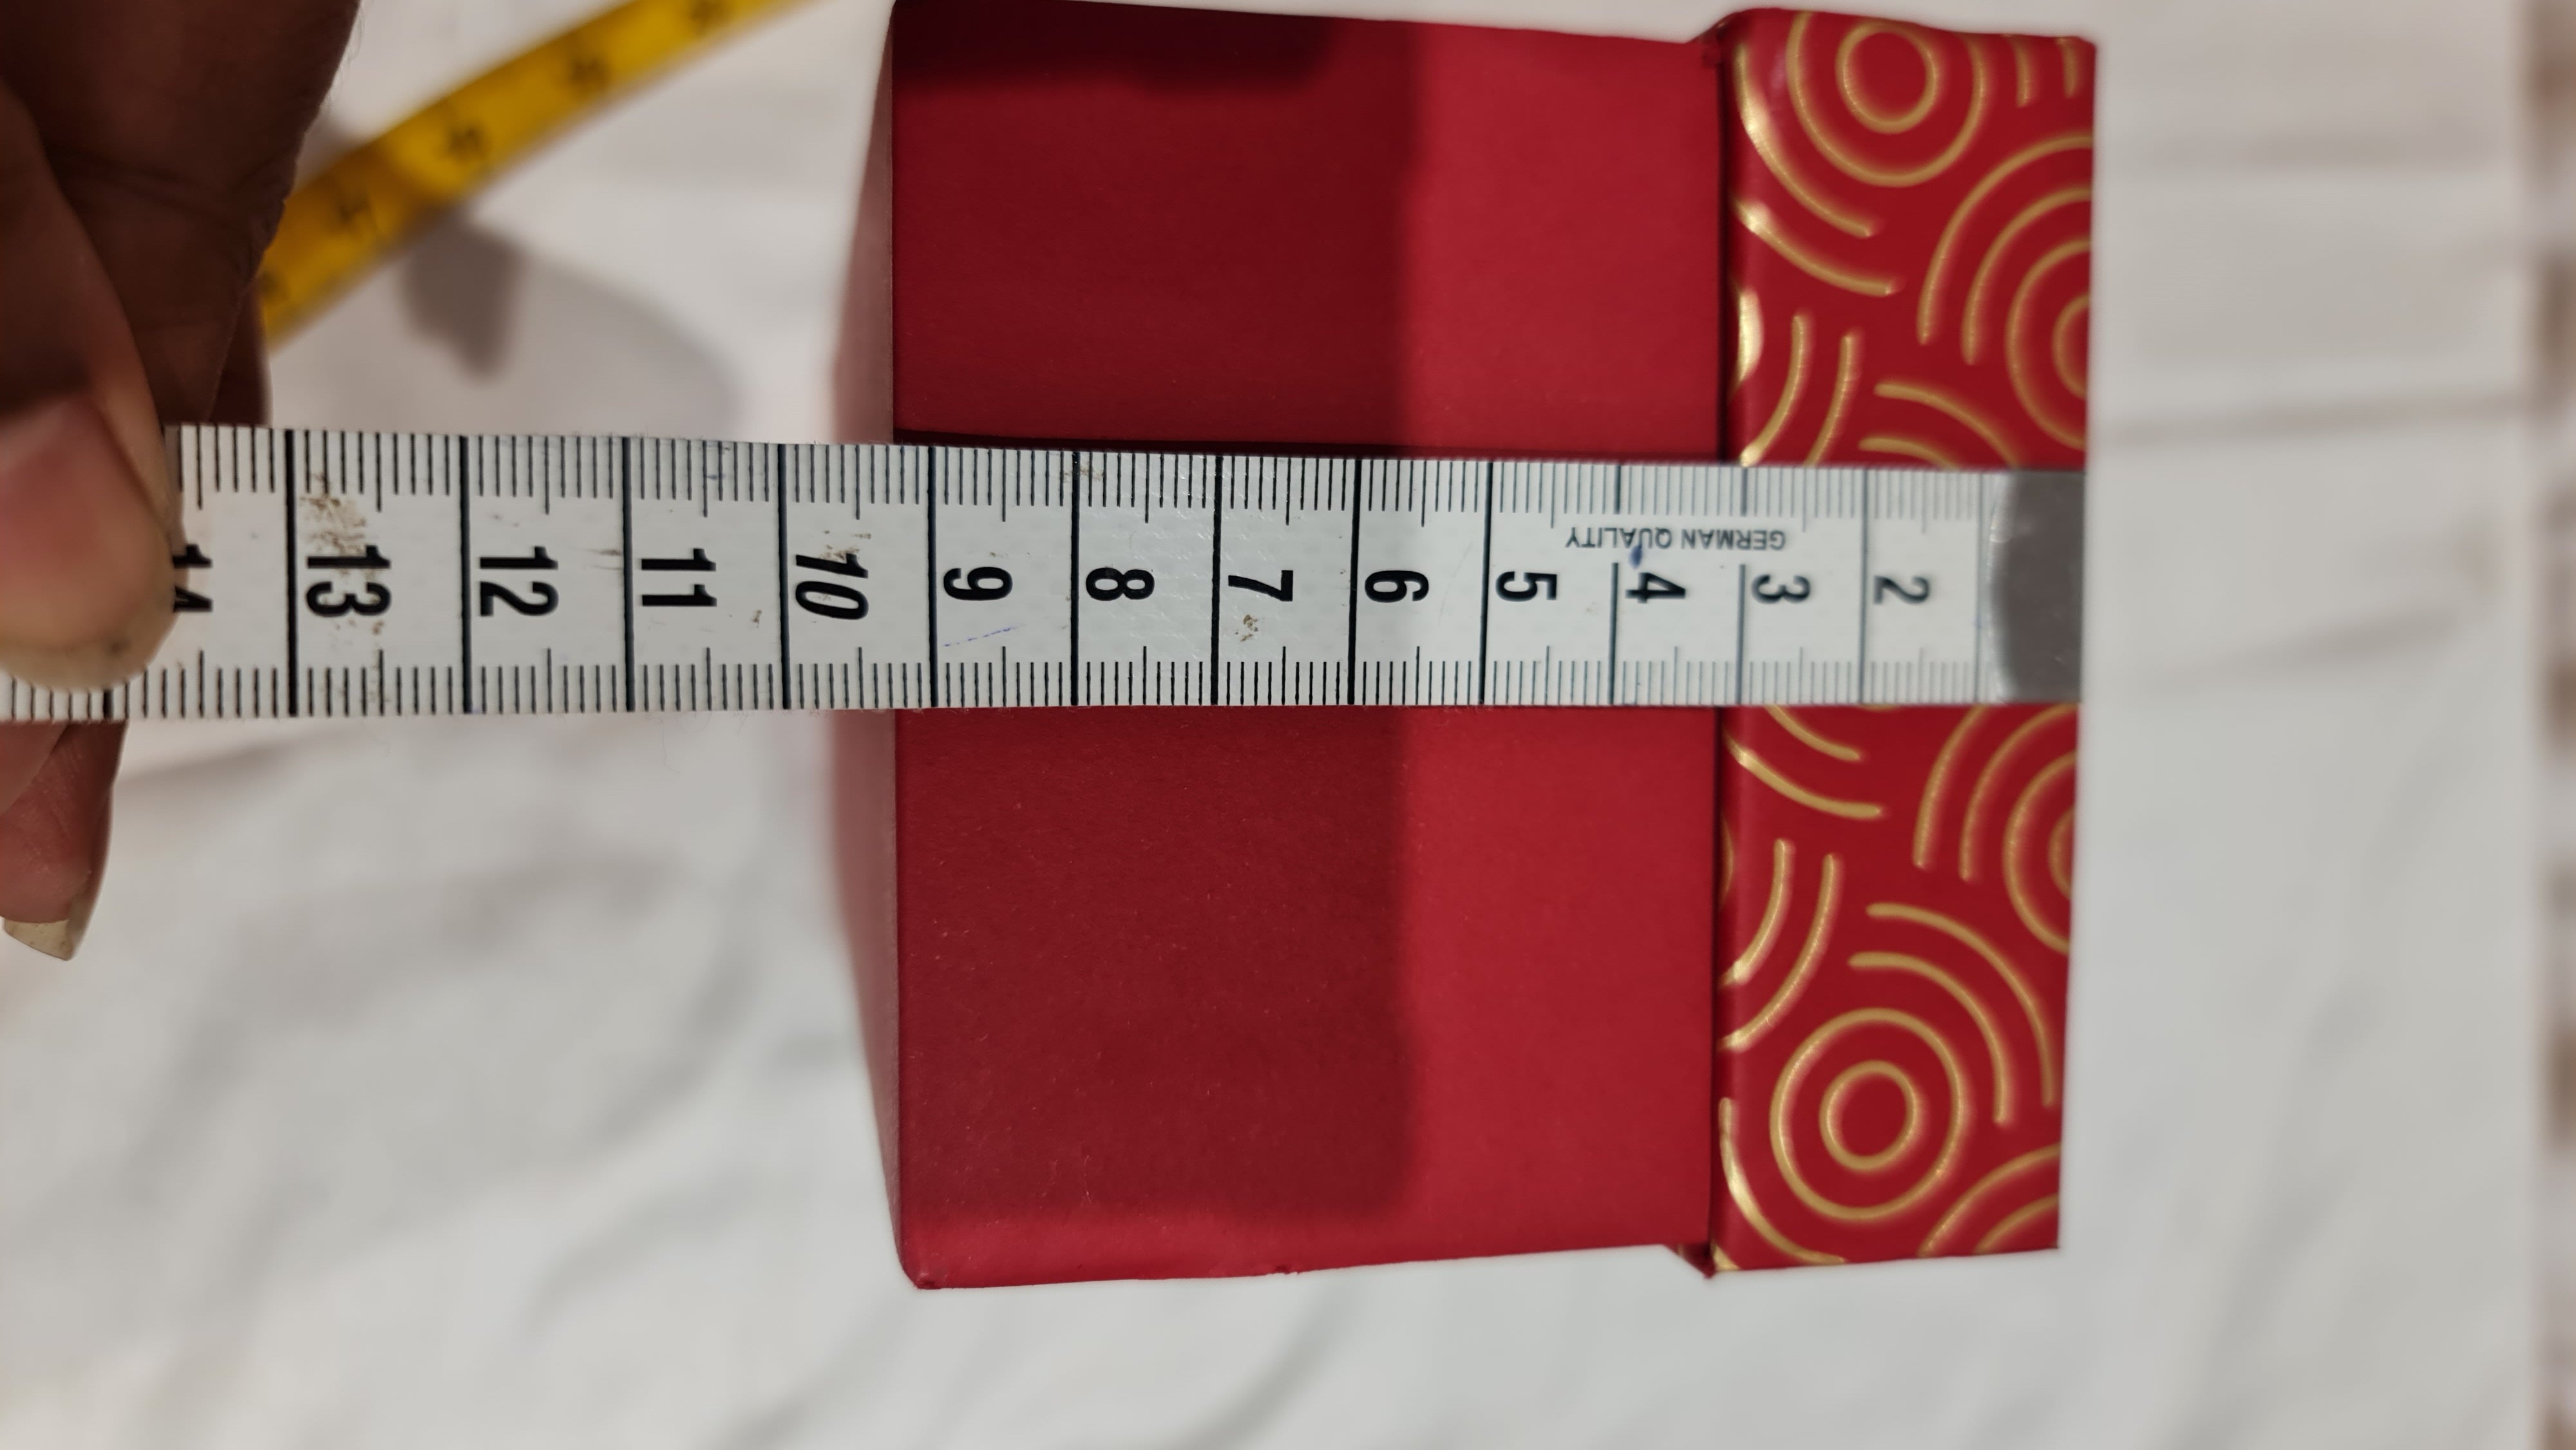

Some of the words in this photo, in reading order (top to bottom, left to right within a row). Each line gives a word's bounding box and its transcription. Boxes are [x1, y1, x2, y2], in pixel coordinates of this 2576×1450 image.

[1565, 525, 1672, 549] QUALITY
[1680, 527, 1786, 551] GERMAN
[305, 544, 392, 619] 13
[478, 545, 560, 618] 12
[640, 547, 718, 608] 11
[794, 551, 869, 621] 10
[942, 565, 1014, 602] 9
[1084, 565, 1156, 602] 8
[1227, 569, 1294, 603] 7
[1363, 569, 1430, 604] 6
[1495, 570, 1558, 603] 5
[1625, 570, 1688, 605] 4
[1750, 572, 1813, 605] 3
[1873, 574, 1932, 605] 2
